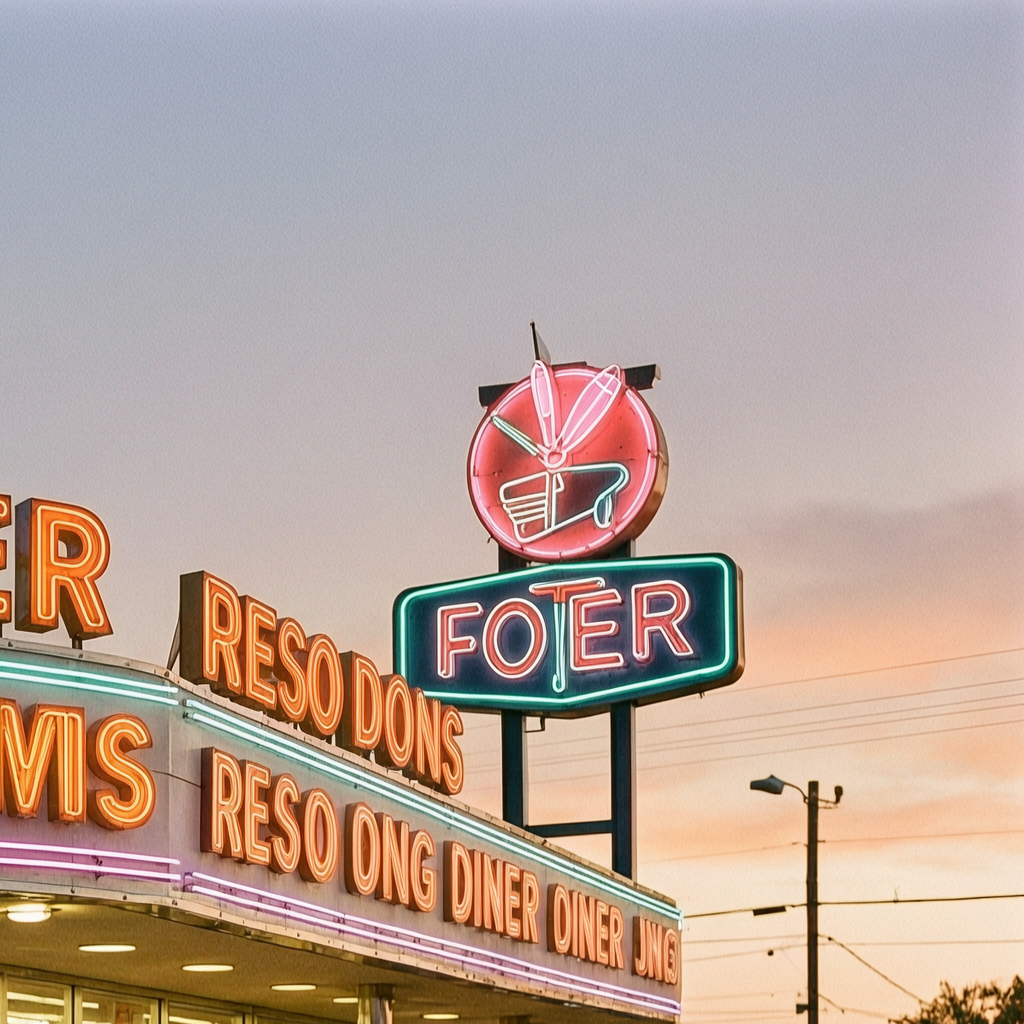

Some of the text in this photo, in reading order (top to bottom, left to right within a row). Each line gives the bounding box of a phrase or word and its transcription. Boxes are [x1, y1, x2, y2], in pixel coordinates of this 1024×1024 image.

[180, 570, 464, 795] RESO DONS
[436, 577, 694, 693] FOTER
[201, 747, 339, 883] RESO
[345, 802, 437, 913] ONG
[443, 841, 540, 944] DINER
